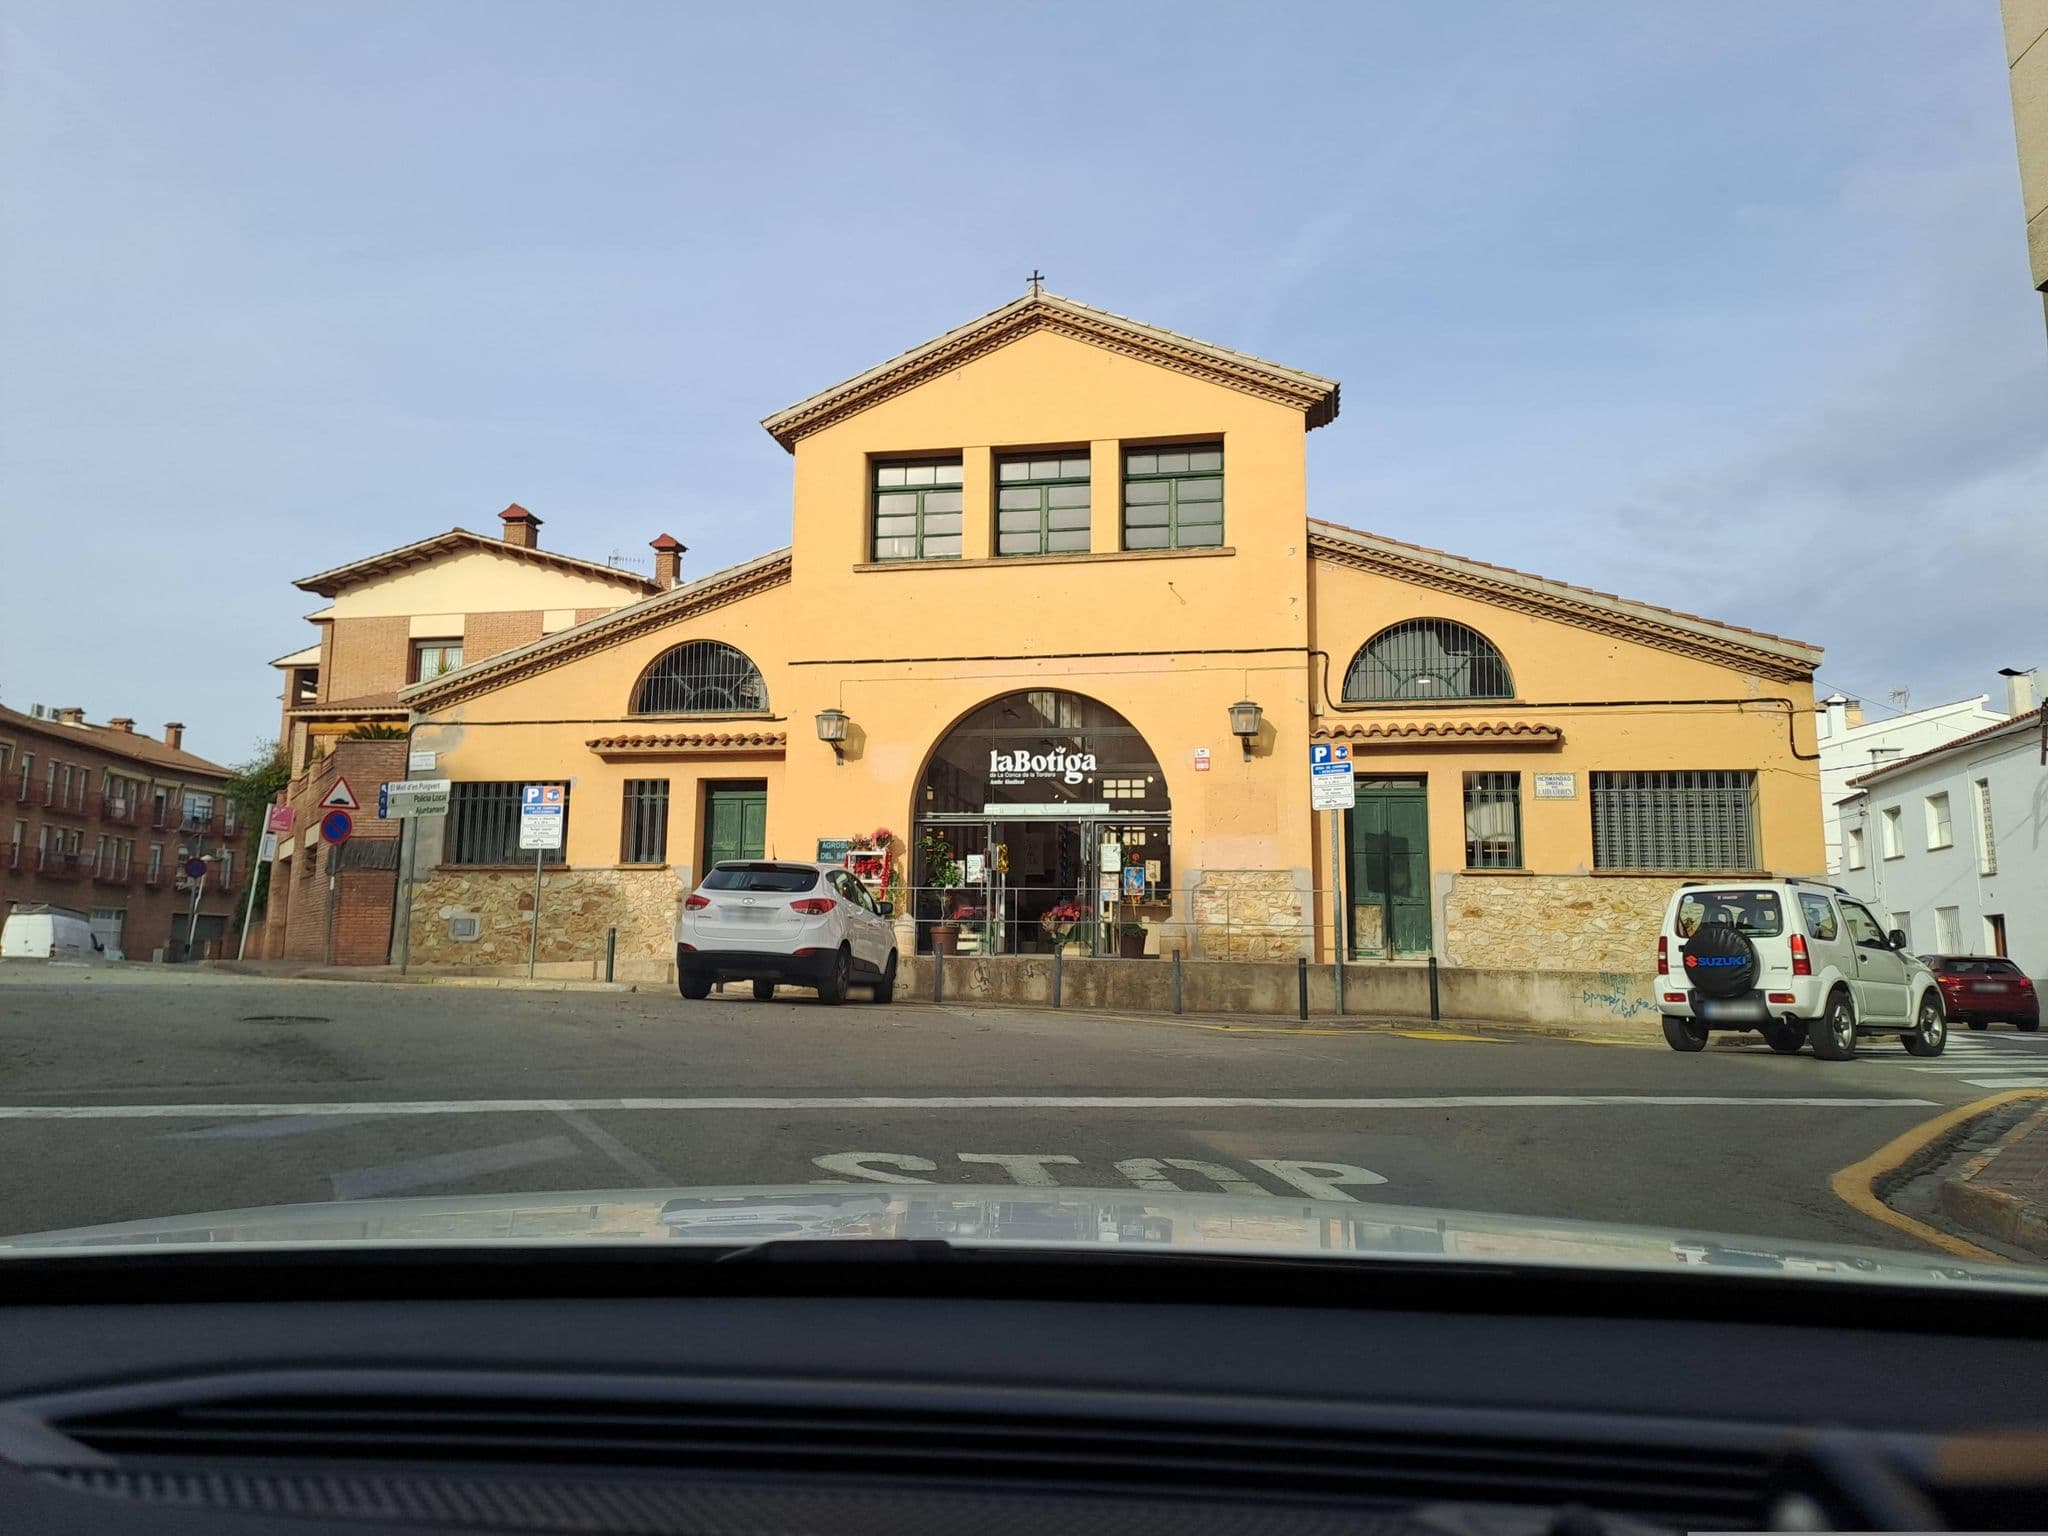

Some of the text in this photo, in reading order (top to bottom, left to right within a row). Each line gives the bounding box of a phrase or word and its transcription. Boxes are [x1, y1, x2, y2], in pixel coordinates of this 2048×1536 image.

[1314, 746, 1327, 763] P
[990, 746, 1097, 784] laBotiga
[432, 793, 447, 802] Local
[527, 788, 540, 803] P
[415, 806, 446, 816] Ajuntament
[1698, 955, 1747, 967] SUZUKI
